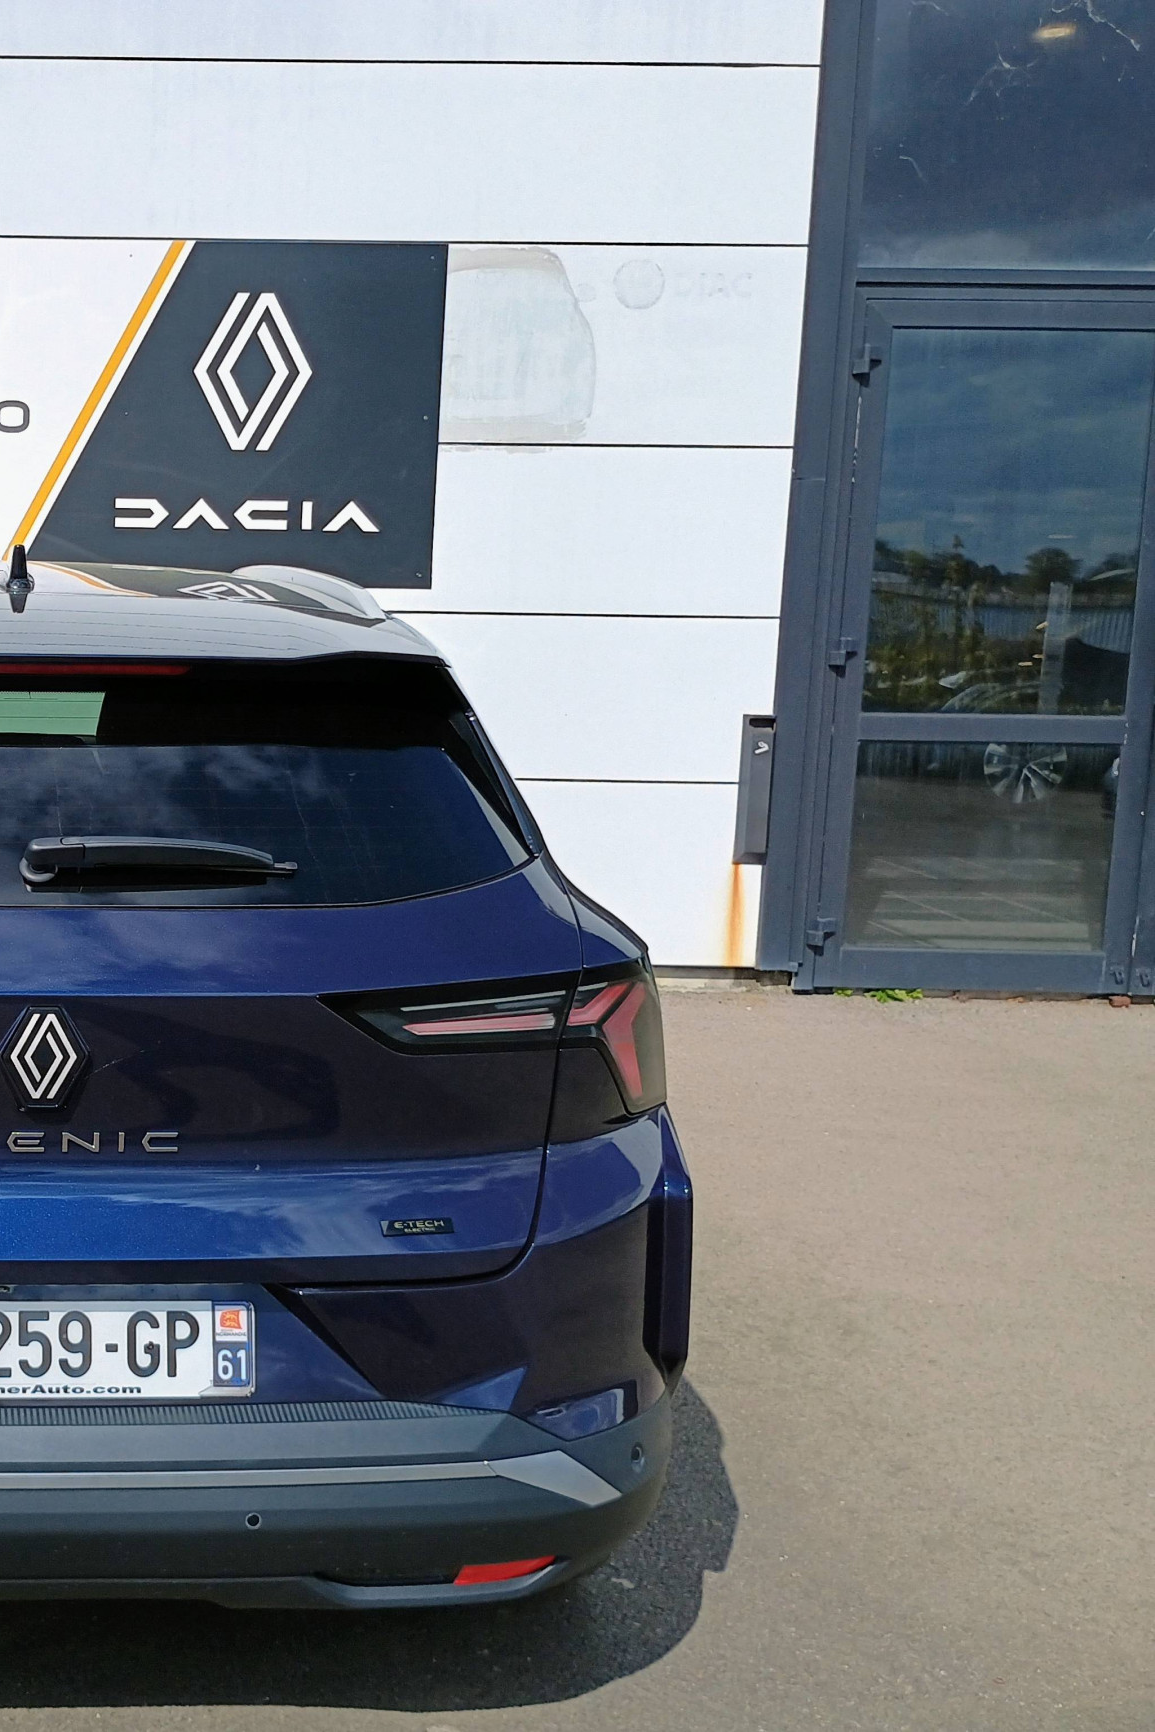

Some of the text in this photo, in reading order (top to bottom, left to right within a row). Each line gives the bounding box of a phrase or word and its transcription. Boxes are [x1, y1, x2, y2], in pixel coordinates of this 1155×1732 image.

[114, 497, 381, 533] DACIA
[393, 1219, 445, 1229] E-TECH
[217, 1348, 247, 1382] 61
